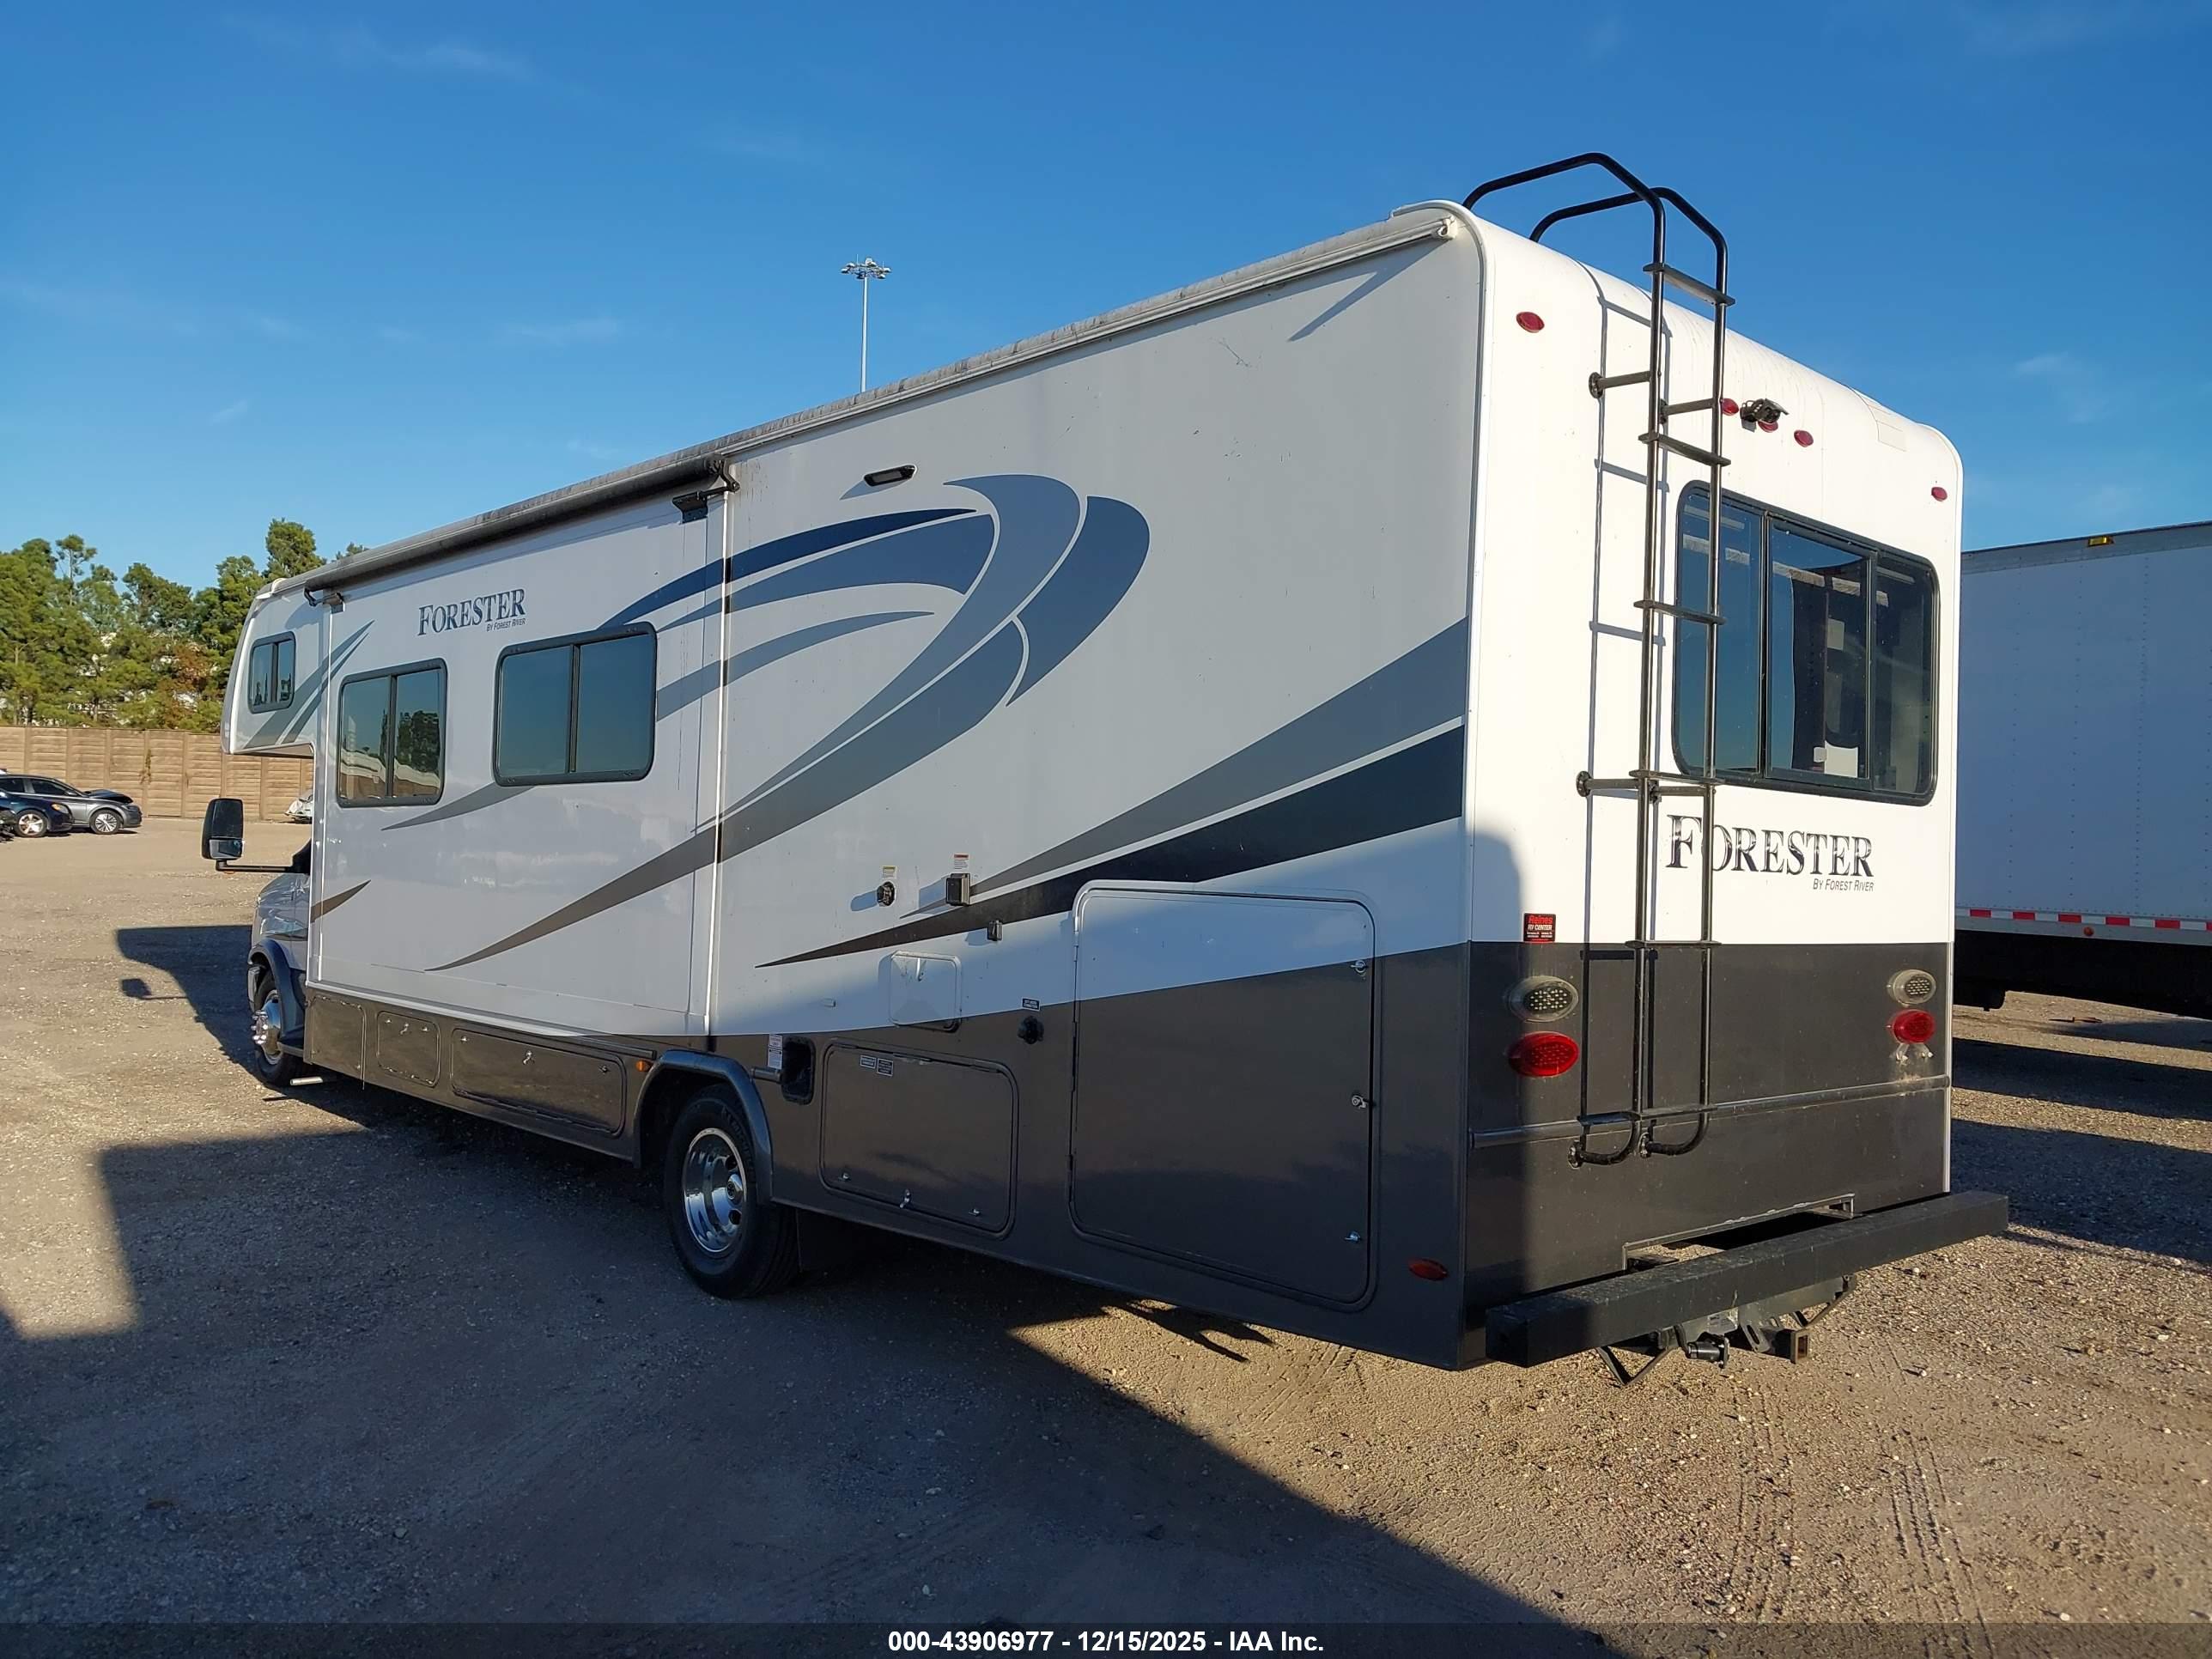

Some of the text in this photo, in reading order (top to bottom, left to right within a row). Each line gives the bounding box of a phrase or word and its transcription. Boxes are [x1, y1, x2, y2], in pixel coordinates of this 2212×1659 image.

[417, 588, 526, 635] FORESTER
[1665, 814, 1874, 878] FORESTER
[1813, 878, 1875, 892] BY FOREST RIVER
